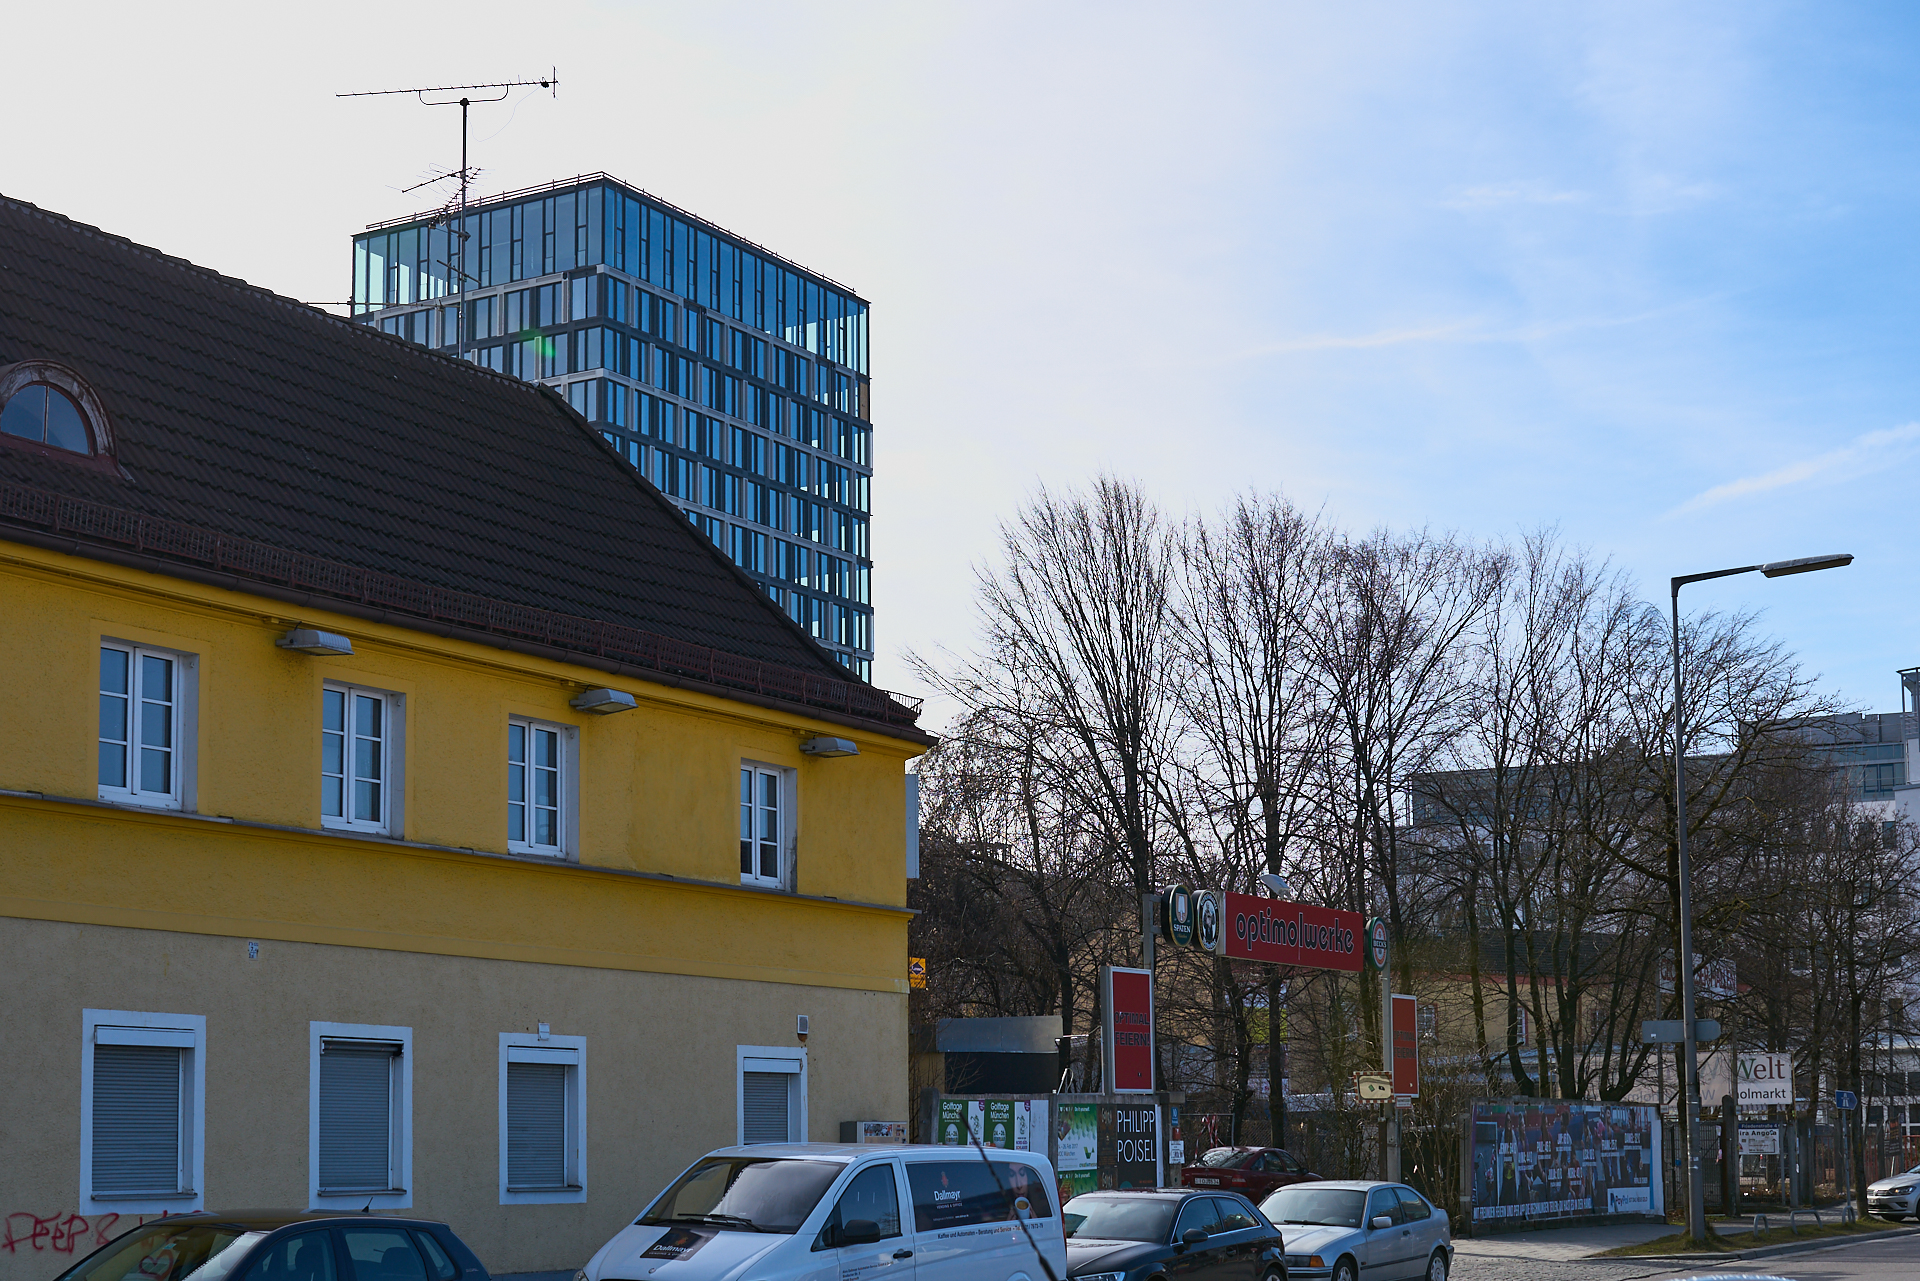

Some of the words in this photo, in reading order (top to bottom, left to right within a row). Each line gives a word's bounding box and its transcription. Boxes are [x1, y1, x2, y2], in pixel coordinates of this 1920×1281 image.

[1173, 923, 1191, 933] SPATEN
[1236, 906, 1354, 954] optimolwerke
[1114, 1011, 1150, 1025] OPTIMAL
[1115, 1032, 1150, 1046] FEIERN!
[1117, 1110, 1155, 1133] PHILIPP
[1117, 1139, 1156, 1163] POISEL
[934, 1190, 961, 1201] Dallmayr
[653, 1244, 693, 1253] Dallmayr
